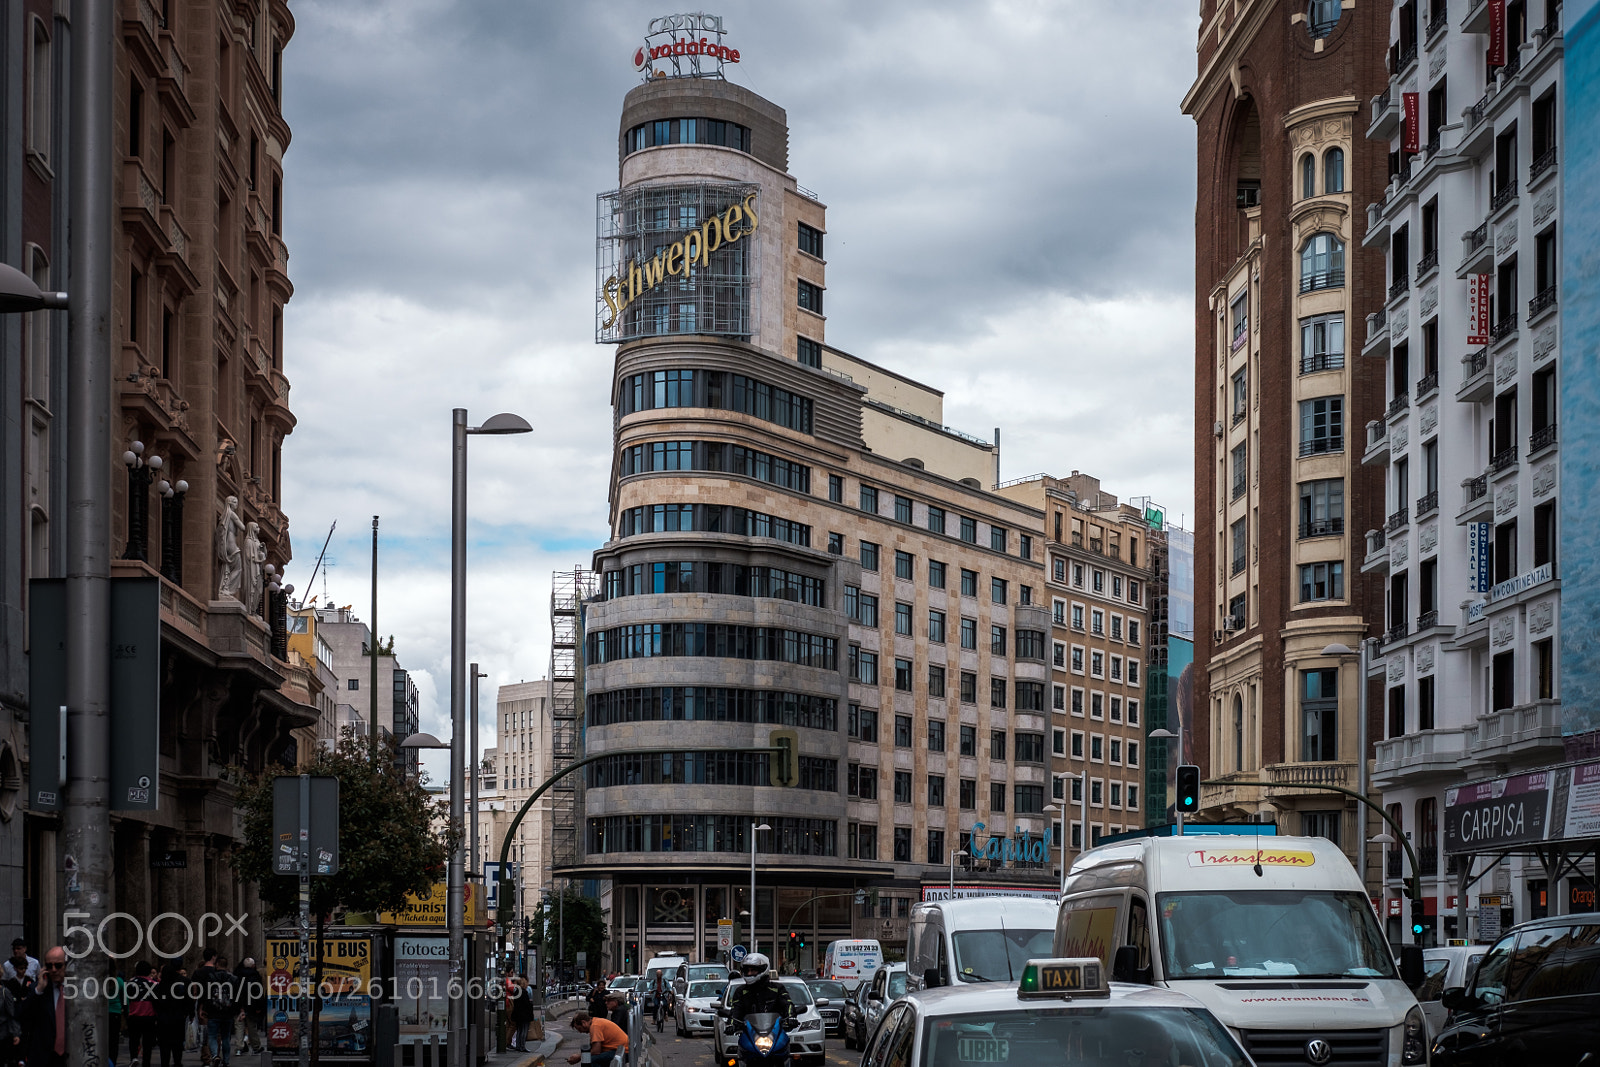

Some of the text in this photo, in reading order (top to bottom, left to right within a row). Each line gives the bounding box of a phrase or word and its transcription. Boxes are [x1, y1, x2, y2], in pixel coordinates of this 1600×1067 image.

[647, 14, 727, 34] CAPITOL
[649, 38, 741, 63] vodafone
[602, 193, 758, 330] Schweppes
[1501, 567, 1550, 596] CONTINENTAL
[1461, 802, 1525, 842] CARPISA
[970, 822, 1052, 868] Capitol
[1195, 850, 1305, 864] Transloan
[338, 942, 368, 957] BUS
[1044, 969, 1079, 987] TAXI
[960, 1039, 1006, 1062] LIBRE
